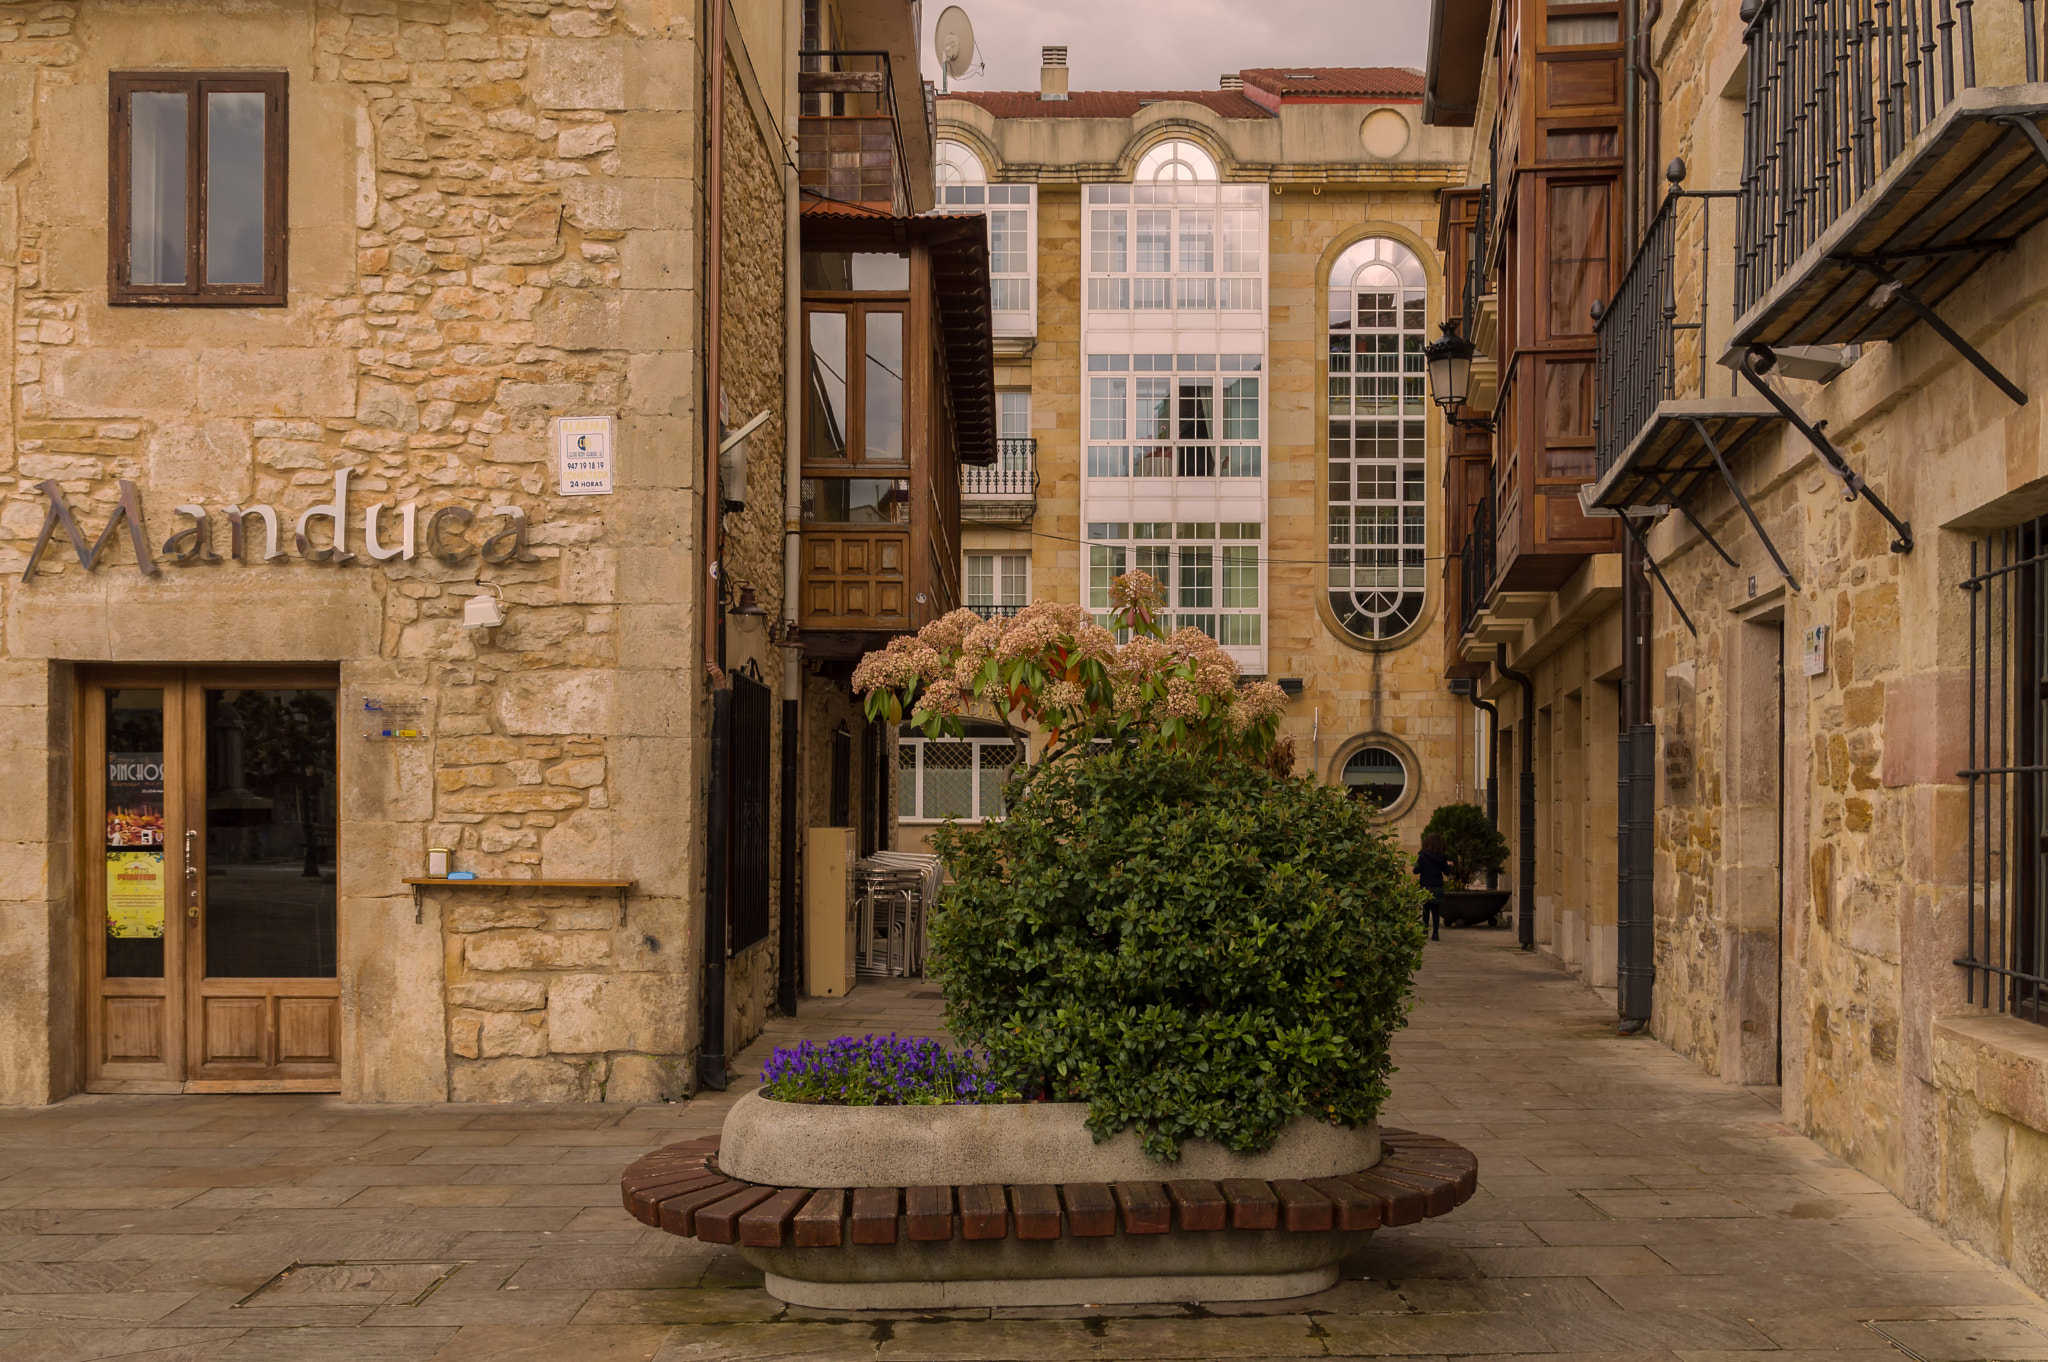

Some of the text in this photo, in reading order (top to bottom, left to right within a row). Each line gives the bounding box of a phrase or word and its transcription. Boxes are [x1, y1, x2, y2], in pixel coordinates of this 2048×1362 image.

[562, 421, 608, 432] ALARMA
[567, 461, 604, 470] 947 19 18 19
[562, 471, 609, 480] CONECTADA
[21, 466, 542, 584] Manduca
